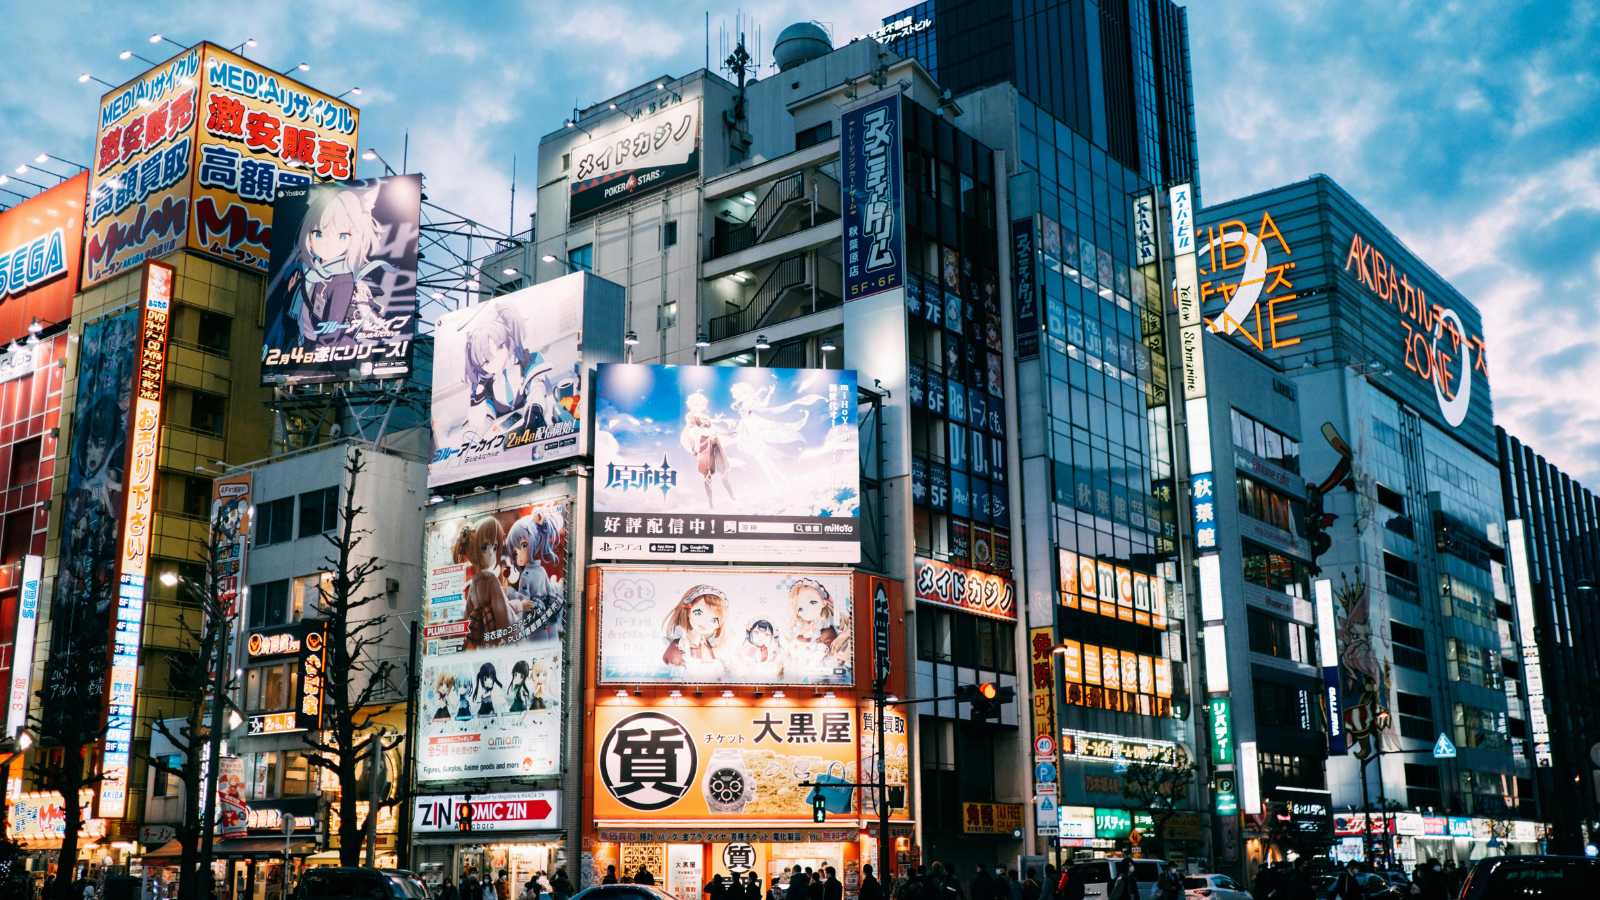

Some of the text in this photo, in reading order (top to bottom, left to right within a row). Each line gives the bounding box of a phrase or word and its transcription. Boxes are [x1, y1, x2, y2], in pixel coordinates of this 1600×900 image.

[209, 62, 355, 133] MEDIAリサイクル
[98, 87, 196, 173] 激安販売
[206, 94, 351, 178] 激安販売
[576, 115, 692, 181] メイドカジノ
[92, 140, 188, 226] 高額買取
[604, 170, 661, 199] POKER STARS
[1175, 190, 1190, 250] スーパービル
[87, 196, 188, 281] Mulan
[848, 227, 859, 277] 秋葉原店
[926, 302, 942, 324] 7F
[1180, 285, 1192, 322] Yellow
[147, 311, 166, 323] DVD
[145, 331, 164, 342] ゲーム
[147, 342, 161, 352] CD
[265, 341, 410, 366] 2月4日遂にリリース!
[143, 360, 162, 371] アニメ
[1183, 331, 1196, 393] Submarine
[1401, 322, 1456, 400] ZONE
[141, 380, 159, 391] ホビー
[142, 371, 160, 382] コミック
[928, 391, 945, 412] 6F
[604, 452, 677, 507] 原神
[931, 484, 947, 507] 5F
[1077, 482, 1127, 521] 秋葉館
[1193, 478, 1216, 548] 秋葉館
[604, 516, 717, 535] 好評配信中!
[824, 523, 854, 534] miHoYo
[1164, 522, 1176, 537] 5F
[431, 580, 450, 591] ココア
[917, 564, 1013, 613] メイドカジノ
[22, 579, 38, 619] SEGA
[117, 621, 127, 630] 4F
[114, 645, 125, 654] 3F
[114, 682, 133, 693] 買取
[109, 705, 118, 714] 1F
[1328, 687, 1340, 736] GALLERIA
[107, 729, 129, 740] DVD
[752, 712, 852, 745] 大黒屋
[1213, 702, 1228, 760] リバティー
[488, 735, 523, 748] amiami
[705, 734, 746, 747] チケット
[1039, 740, 1051, 750] 40
[464, 763, 479, 772] Anime
[480, 762, 495, 773] goods
[496, 763, 506, 771] and
[102, 790, 123, 800] AKIBA
[418, 797, 452, 830] ZIN
[506, 802, 528, 819] ZIN
[966, 803, 995, 827] 免税
[996, 804, 1007, 821] TAX
[1096, 815, 1131, 830] リバティー
[143, 827, 172, 842] ラーメン
[600, 831, 636, 842] 高価買取
[675, 861, 696, 869] 大黒屋
